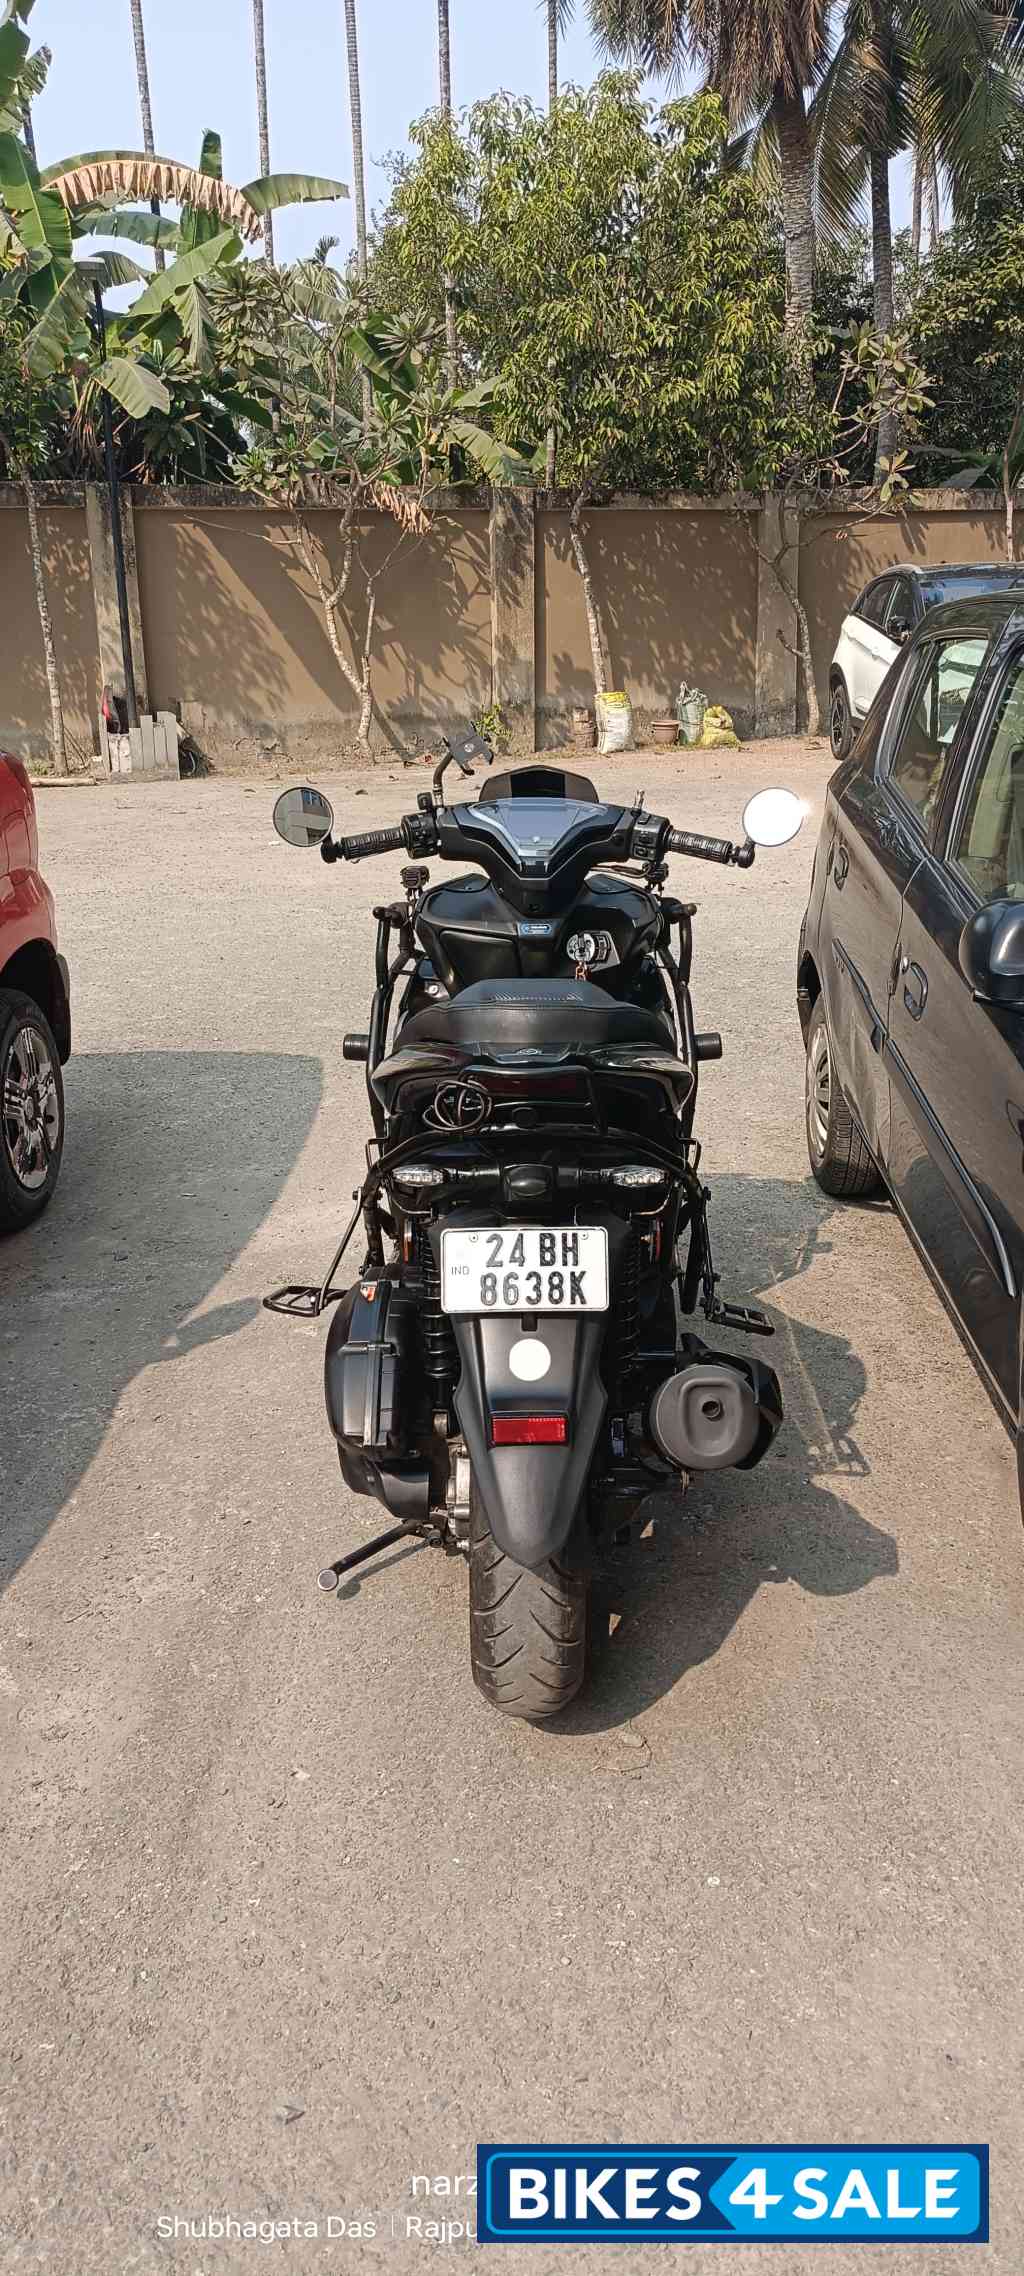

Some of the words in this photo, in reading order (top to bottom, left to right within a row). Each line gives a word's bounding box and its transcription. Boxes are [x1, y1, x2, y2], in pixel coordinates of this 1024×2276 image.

[486, 1232, 526, 1267] 24
[539, 1232, 579, 1267] BH
[480, 1270, 587, 1306] 8638K
